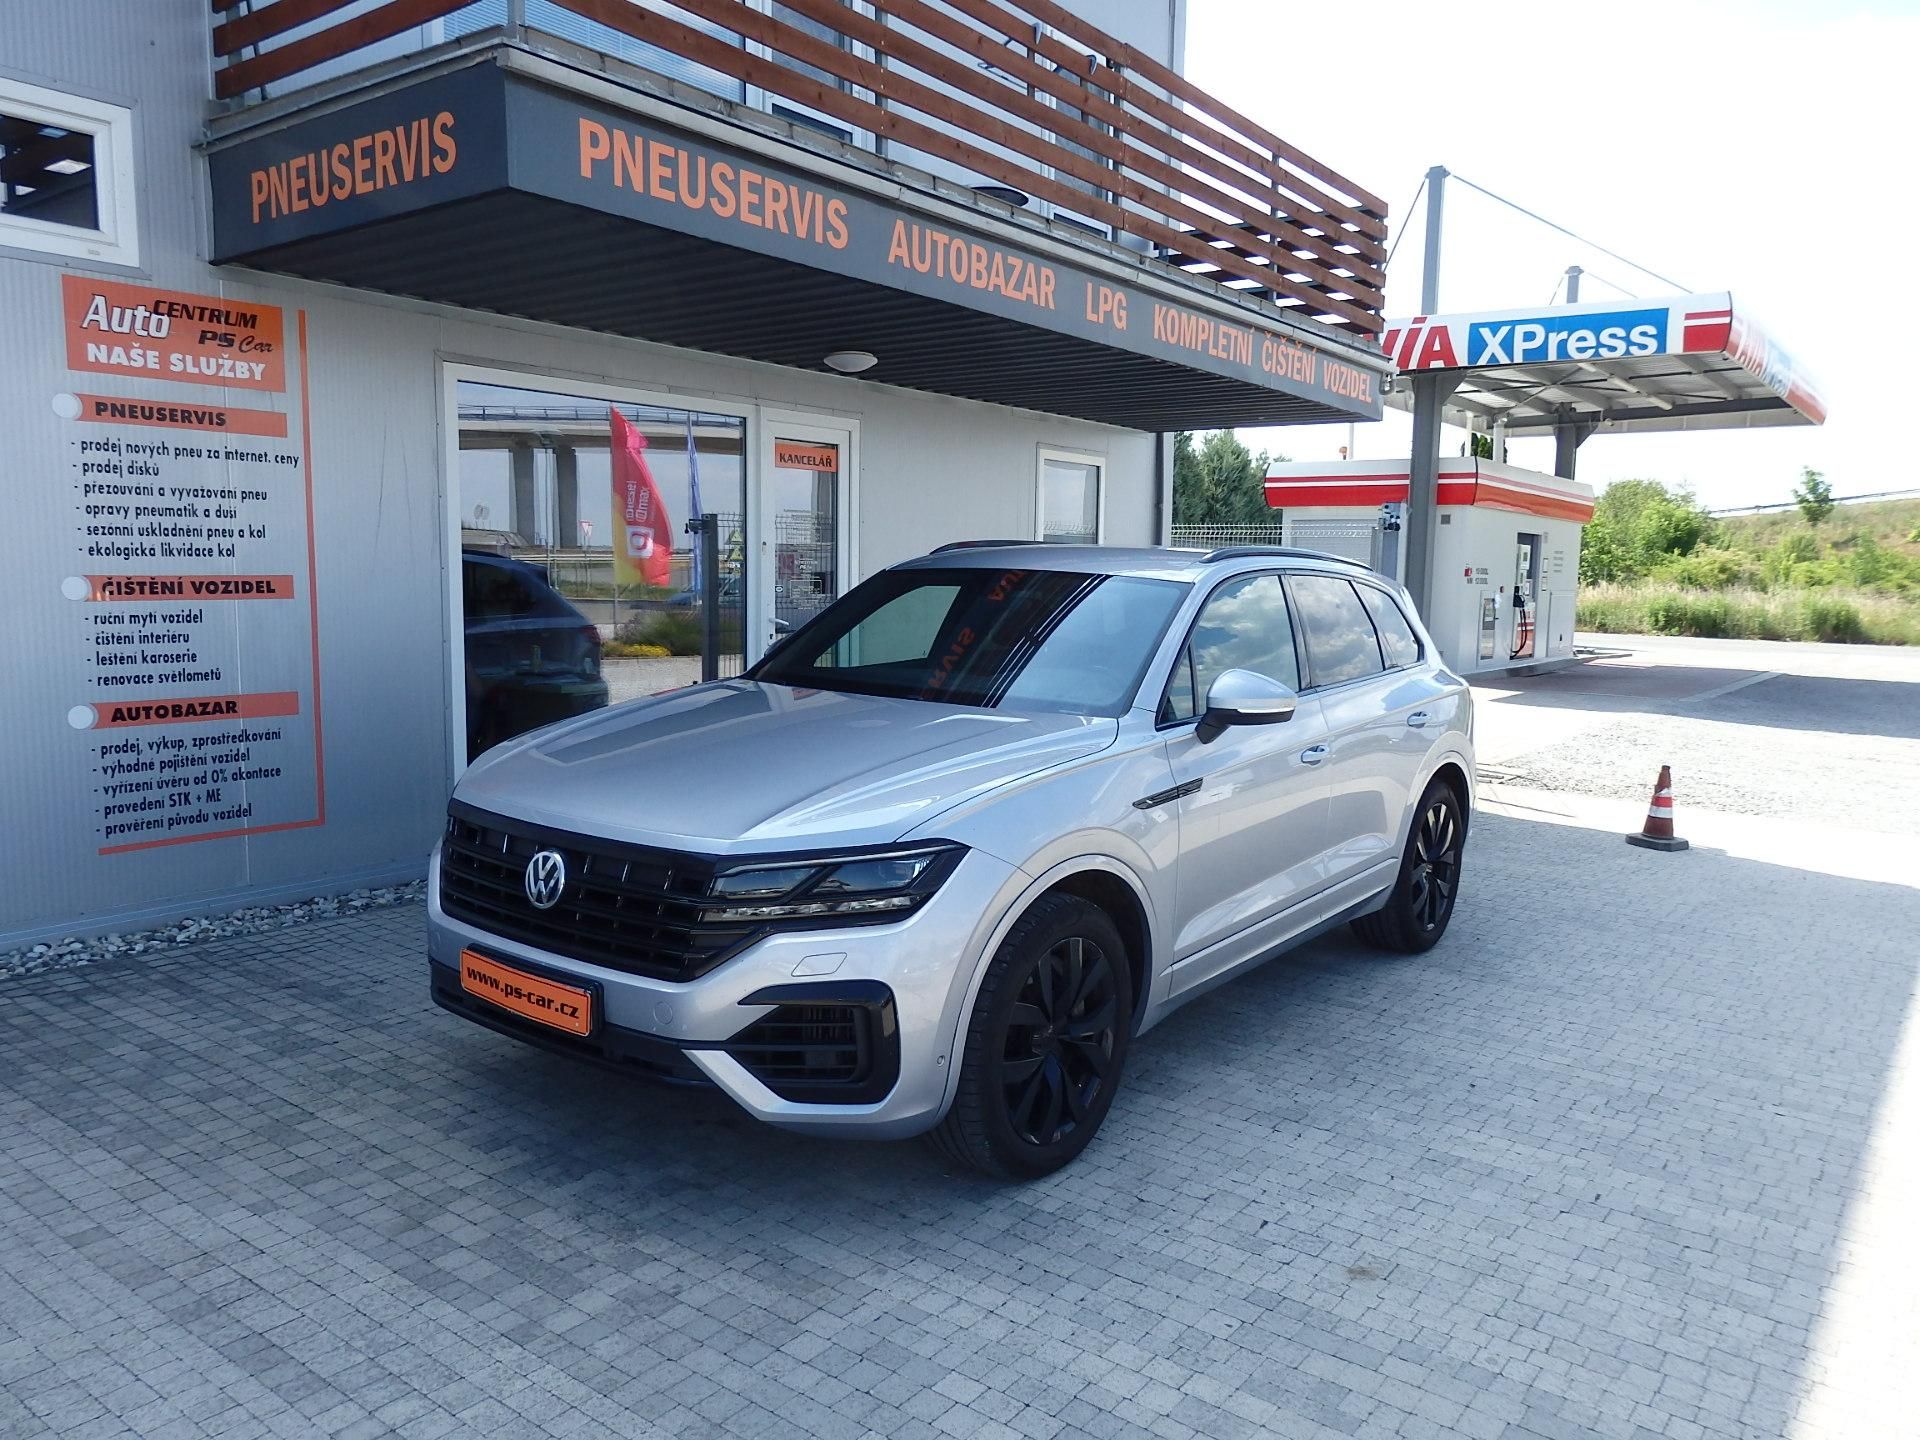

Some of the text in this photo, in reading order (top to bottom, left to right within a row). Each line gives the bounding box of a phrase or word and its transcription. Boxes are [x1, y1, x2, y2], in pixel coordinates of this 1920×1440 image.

[250, 111, 457, 224] PNEUSERVIS
[579, 117, 1372, 404] PNEUSERVIS AUTOBAZAR LPG KOMPLETNÍ ČIŠTĚNÍ VOZIDEL
[80, 294, 171, 339] Auto
[154, 300, 257, 329] CENTRUM
[198, 330, 274, 353] PS Car
[1477, 322, 1659, 364] XPress
[87, 342, 266, 380] NAŠE SLUŽBY
[95, 402, 226, 426] PNEUSERVIS
[81, 438, 299, 468] prodej nových pneu za internet. ceny
[780, 453, 832, 468] KANCELÁŘ
[82, 460, 122, 478] prodej
[158, 486, 166, 496] a
[241, 488, 267, 503] pneu
[86, 504, 130, 519] opravy
[135, 503, 199, 520] pneumatik
[204, 506, 210, 518] a
[207, 526, 234, 541] pneu
[238, 527, 244, 538] a
[250, 524, 266, 538] kol
[161, 543, 214, 557] likvidace
[218, 544, 234, 557] kol
[102, 577, 276, 595] ČIŠTĚNÍ VOZIDEL
[162, 610, 202, 624] vozidel
[139, 630, 189, 644] interiéru
[142, 649, 197, 664] karoserie
[98, 673, 154, 686] renovace
[112, 701, 238, 722] AUTOBAZAR
[101, 728, 281, 758] prodej, výkup, zprostředkování
[102, 748, 250, 778] výhodné pojištění vozidel
[104, 778, 152, 798] vyřízení
[194, 771, 207, 785] od
[212, 769, 228, 782] 0%
[232, 766, 281, 781] akontace
[104, 798, 164, 819] provedení
[169, 792, 192, 808] STK
[206, 788, 221, 804] ME
[106, 803, 252, 838] prověření původu vozidel
[466, 966, 580, 1020] www.ps-car.cz
